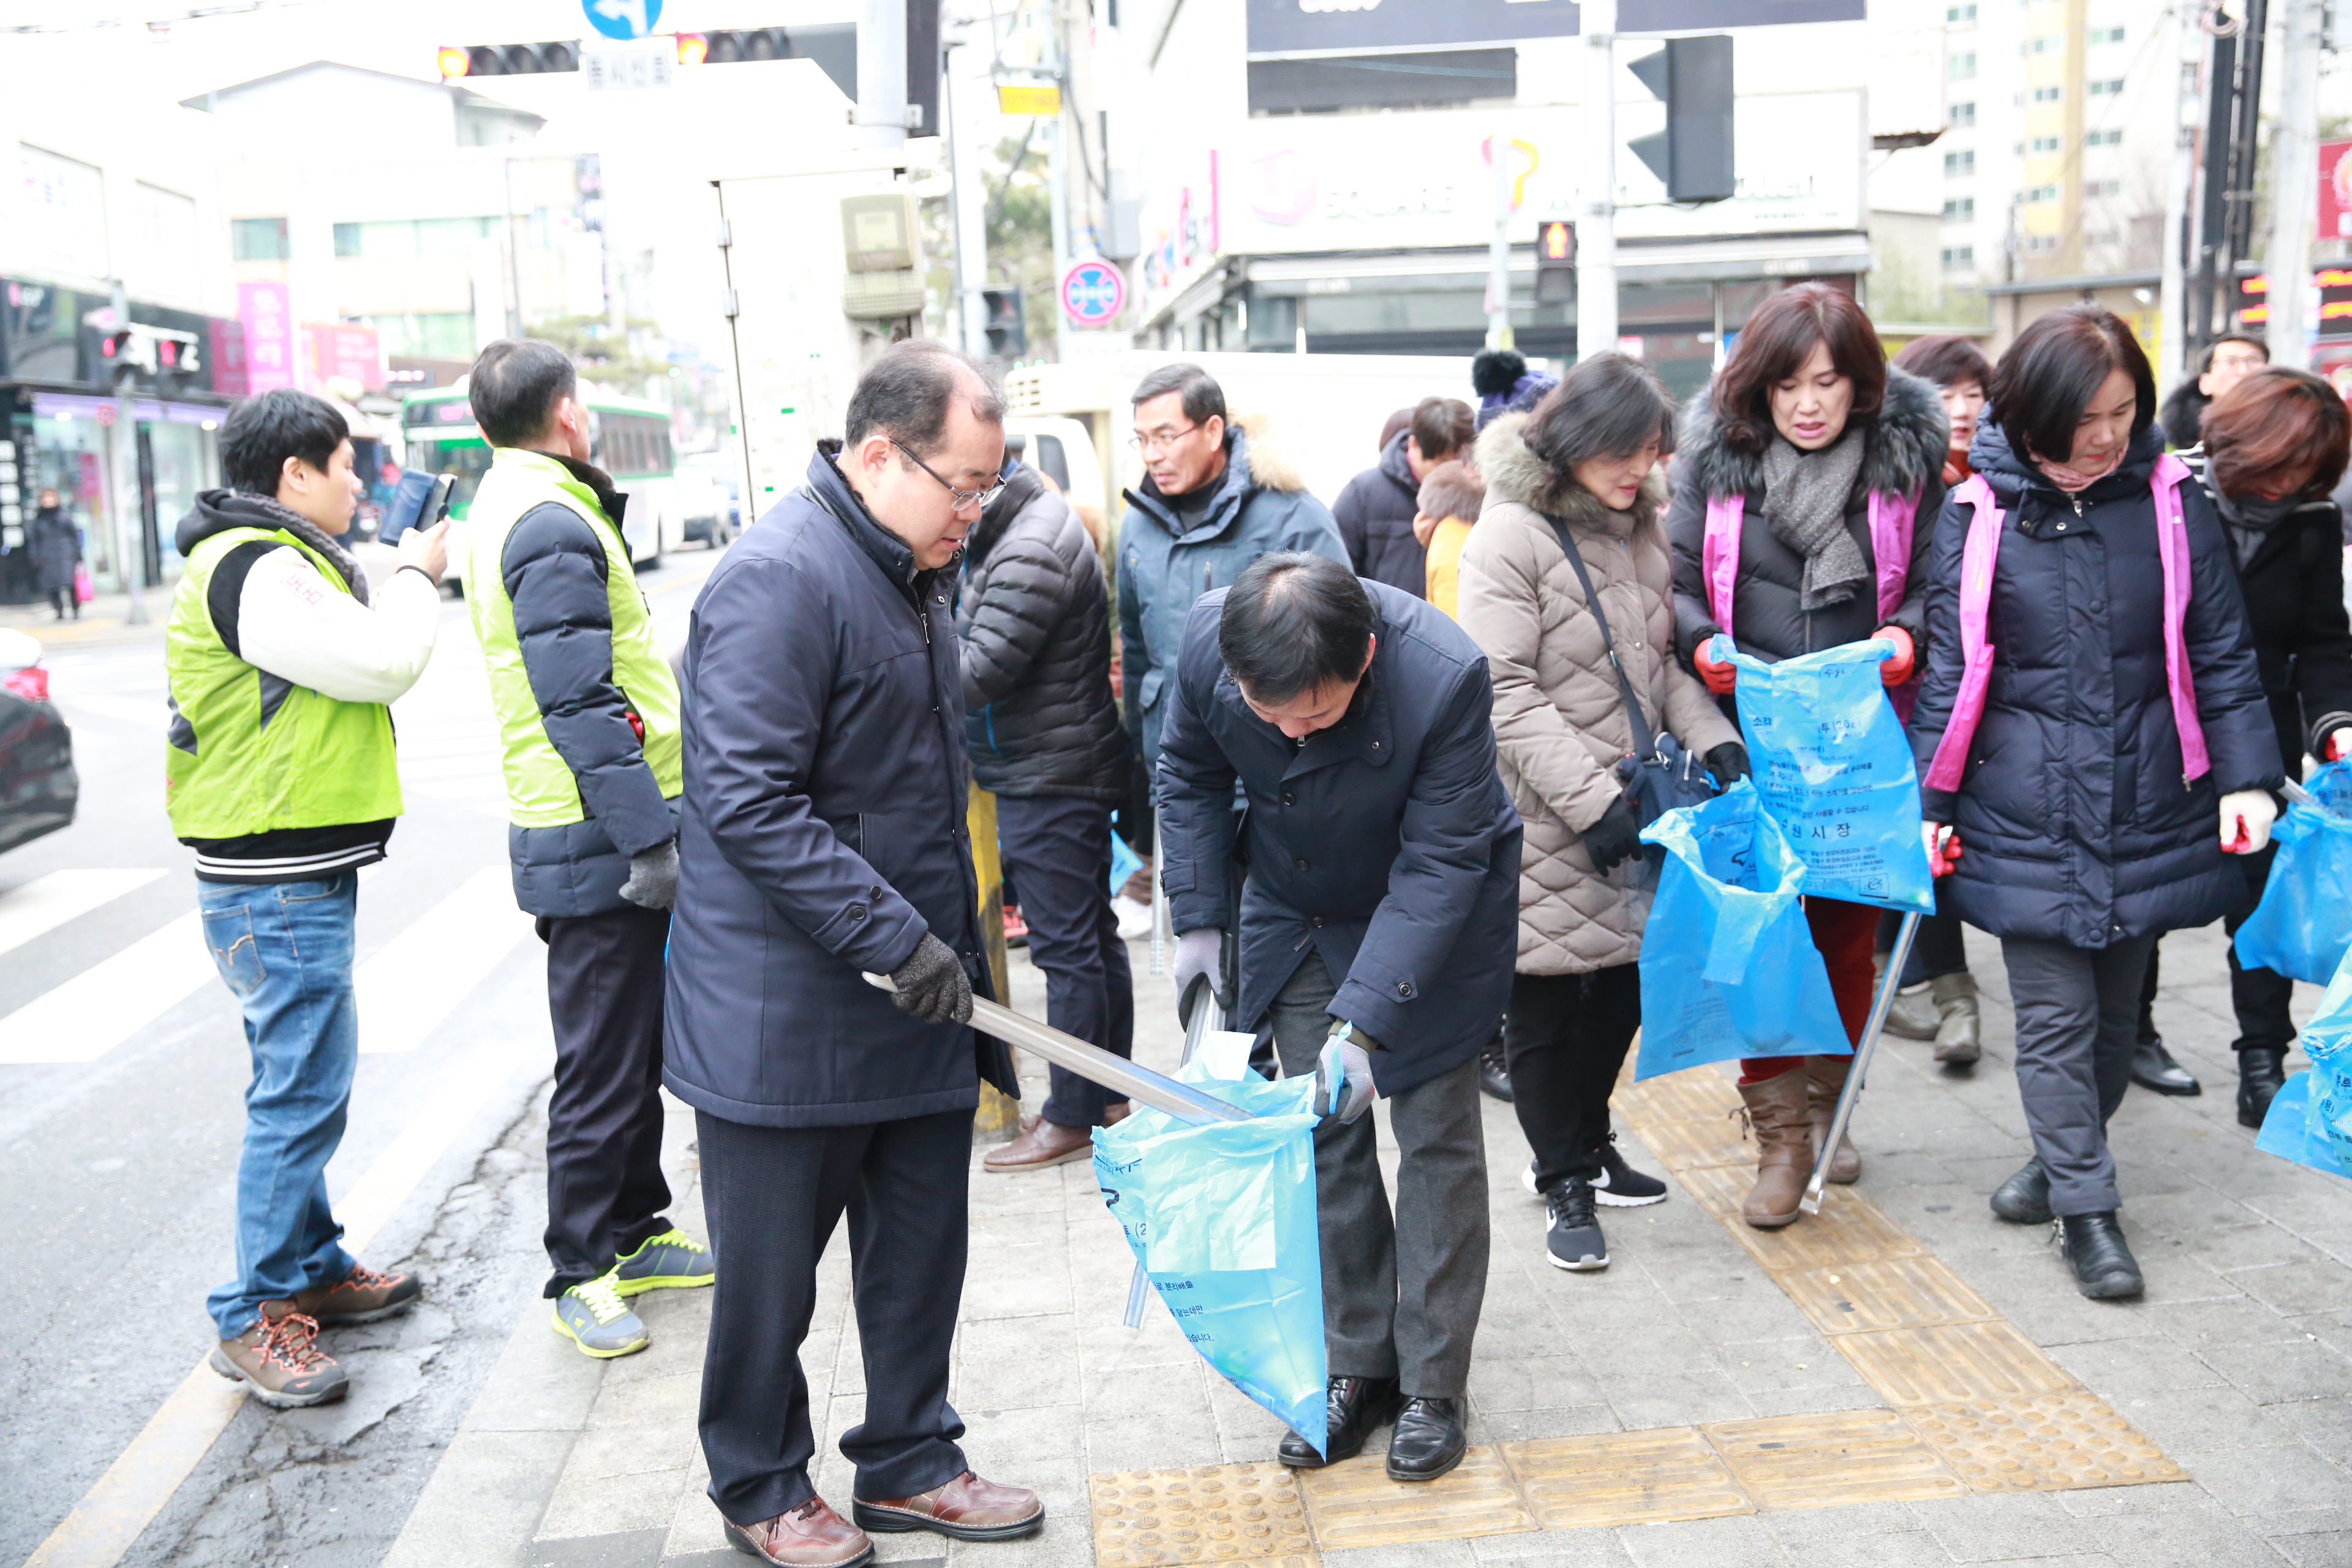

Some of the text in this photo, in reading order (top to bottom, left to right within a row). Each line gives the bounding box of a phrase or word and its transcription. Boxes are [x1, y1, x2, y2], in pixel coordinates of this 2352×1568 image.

[1792, 824, 1801, 838] 원
[1812, 825, 1825, 839] 시
[1837, 823, 1851, 837] 장
[1165, 1280, 1194, 1291] 분리배출
[1176, 1305, 1204, 1317] 담는데만
